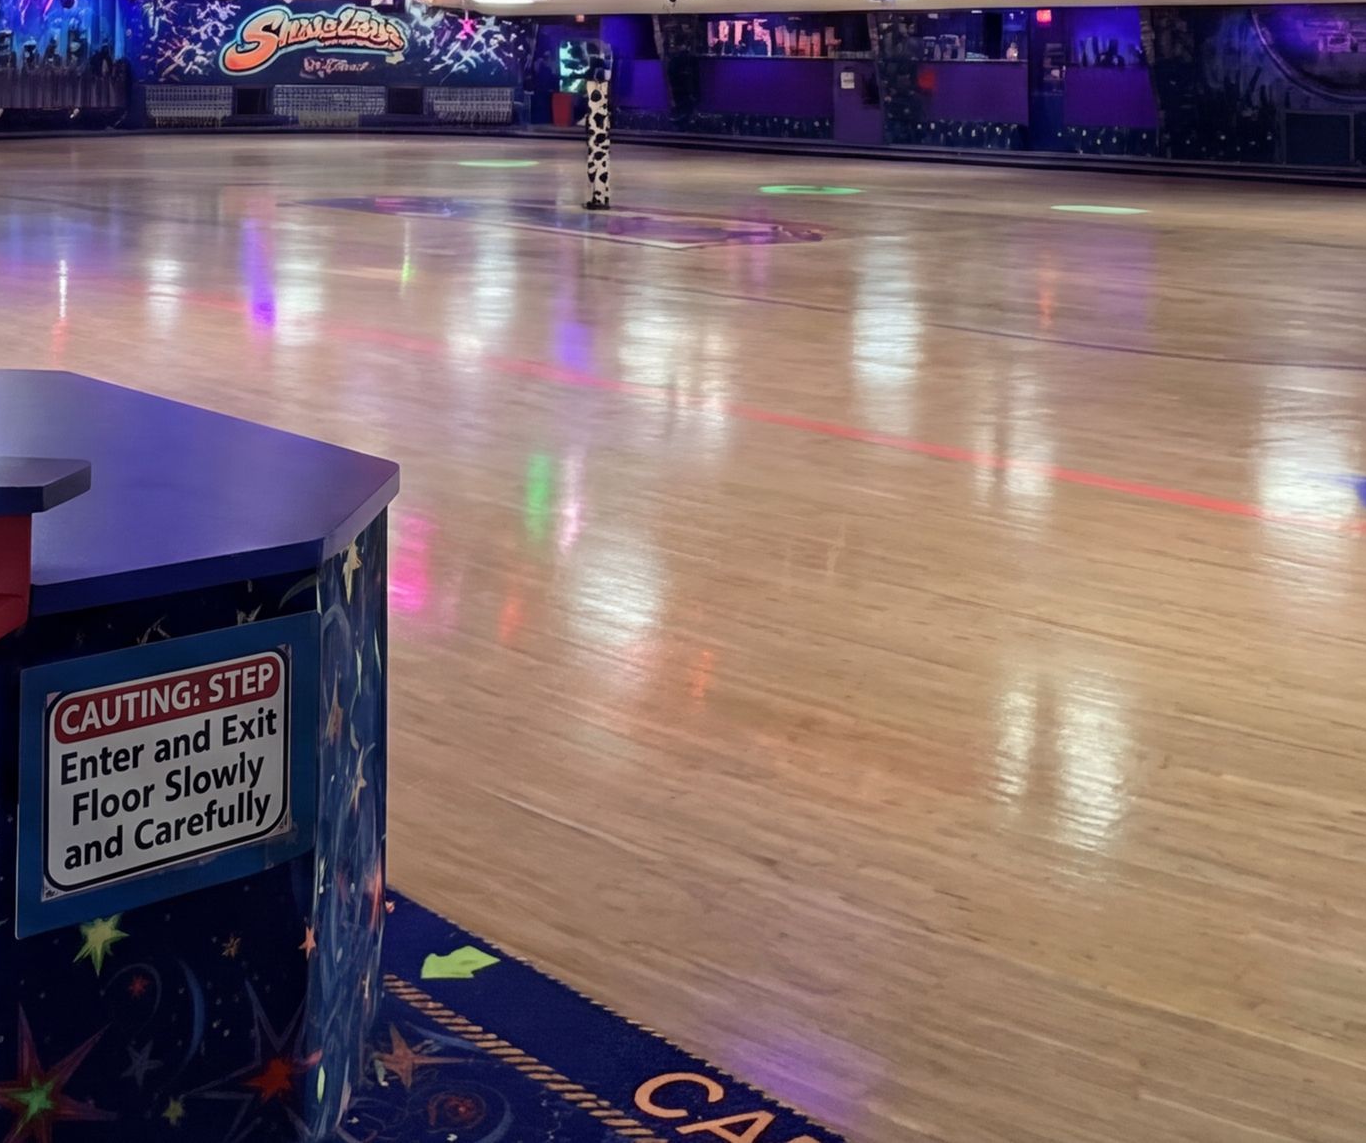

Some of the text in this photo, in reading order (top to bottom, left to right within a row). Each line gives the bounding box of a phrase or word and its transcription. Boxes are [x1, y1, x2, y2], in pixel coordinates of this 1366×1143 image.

[60, 663, 275, 736] CAUTING: STEP
[61, 707, 277, 785] Enter and Exit
[73, 751, 265, 826] Floor Slowly
[64, 790, 272, 870] and Carefully
[635, 1072, 821, 1143] CA
